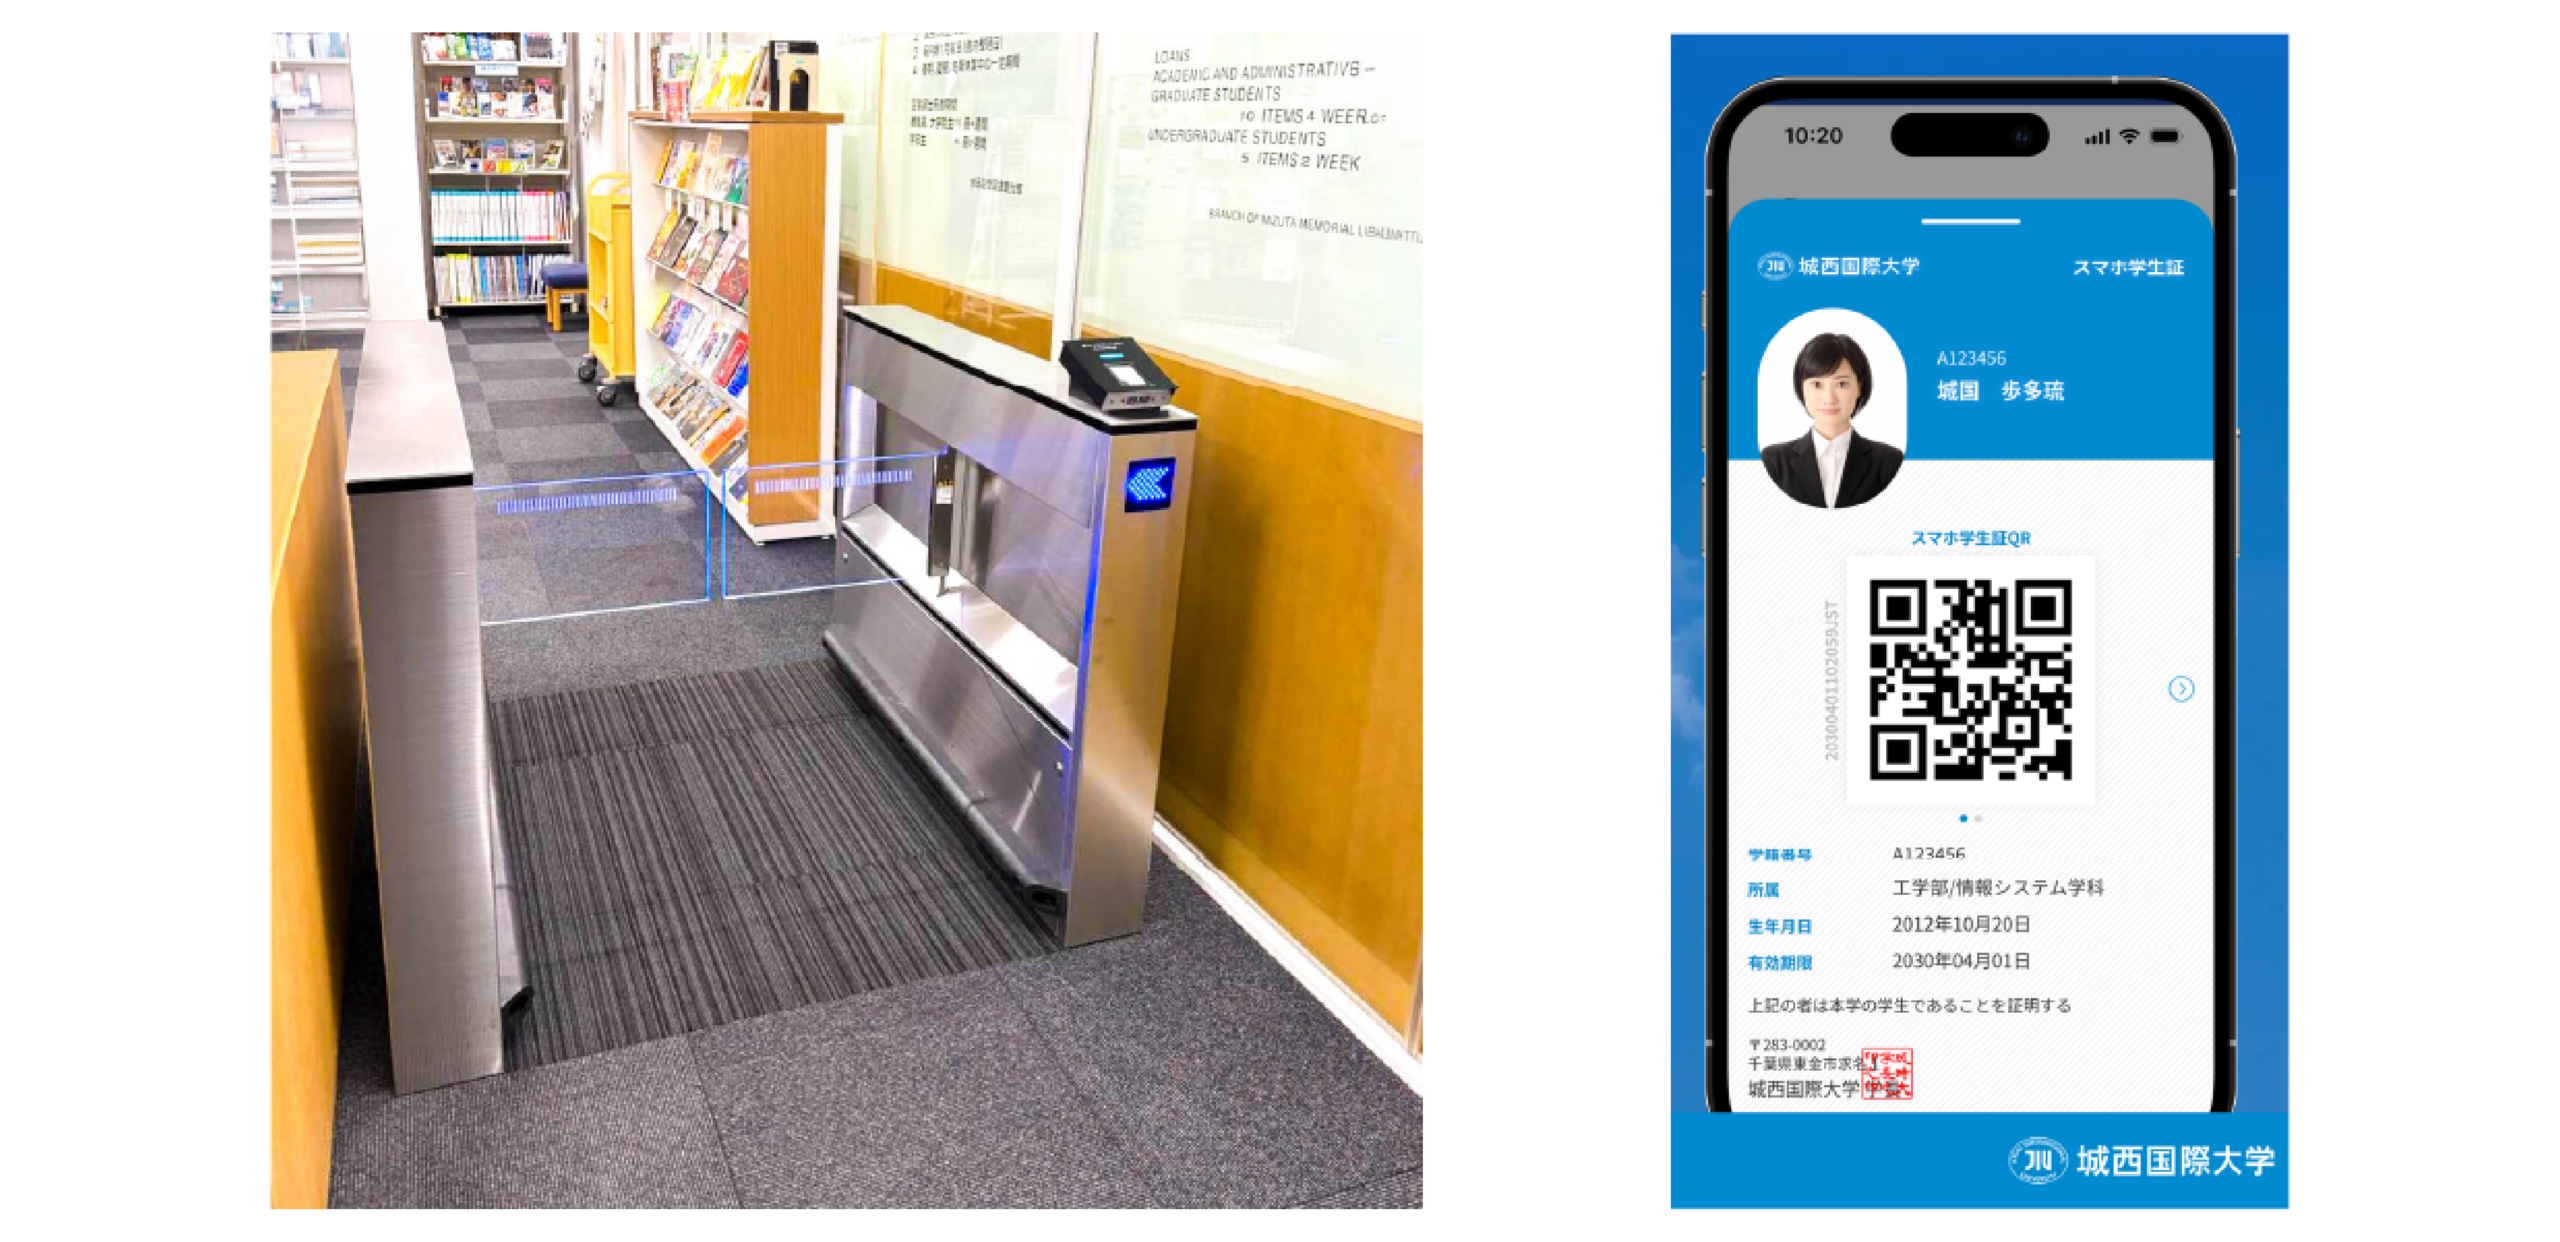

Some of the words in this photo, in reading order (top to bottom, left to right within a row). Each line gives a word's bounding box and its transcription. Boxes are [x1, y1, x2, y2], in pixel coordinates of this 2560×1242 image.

[1154, 49, 1191, 64] LOANS
[1153, 68, 1210, 84] ACADEMIC
[1212, 66, 1238, 81] AND
[1151, 87, 1211, 103] GRADUATE
[1214, 86, 1281, 102] STUDENTS
[1261, 108, 1304, 124] ITEMS
[1252, 130, 1327, 147] STUDENTS
[1785, 127, 1843, 144] 10:20
[1257, 152, 1298, 168] ITEMS
[1316, 153, 1362, 171] WEEK
[1798, 255, 1921, 276] 城西国際大学
[2073, 258, 2185, 277] スマホ学生証
[1937, 350, 2007, 366] A123456
[1937, 379, 1980, 402] 城国
[2000, 379, 2065, 402] 歩多琉
[1912, 530, 2032, 549] スマホ学生証QR
[1825, 600, 1840, 762] 20300401102059JST
[1891, 846, 1966, 861] A123456
[1747, 881, 1780, 899] 所属
[1892, 877, 2106, 900] 工学部/情報システム学科
[1747, 917, 1813, 936] 生年月日
[1891, 914, 2031, 934] 2012年10月20日
[1747, 954, 1814, 972] 有効期限
[1891, 950, 2031, 970] 2030年04月01日
[1747, 996, 2072, 1014] 上記の者は本学の学生であることを証明する
